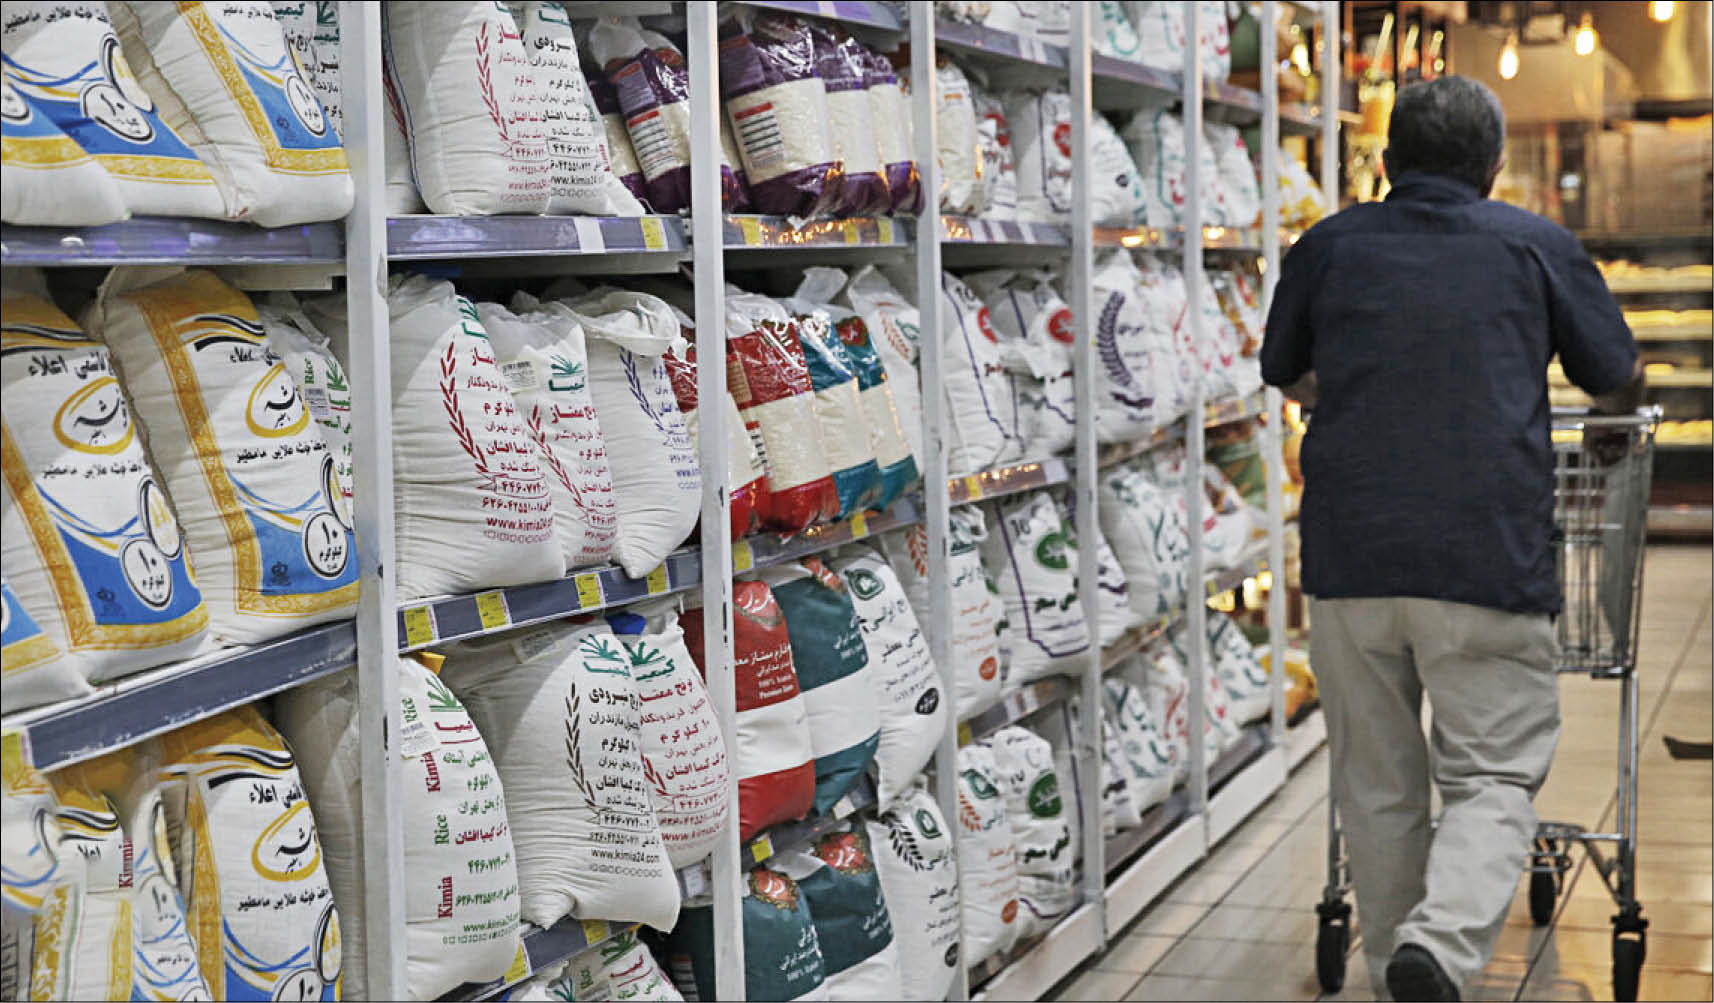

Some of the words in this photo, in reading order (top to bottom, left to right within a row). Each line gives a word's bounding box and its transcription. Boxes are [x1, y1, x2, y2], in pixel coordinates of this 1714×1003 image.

[420, 751, 442, 794] Kimia
[433, 813, 450, 846] Rice
[436, 874, 454, 920] Kimia
